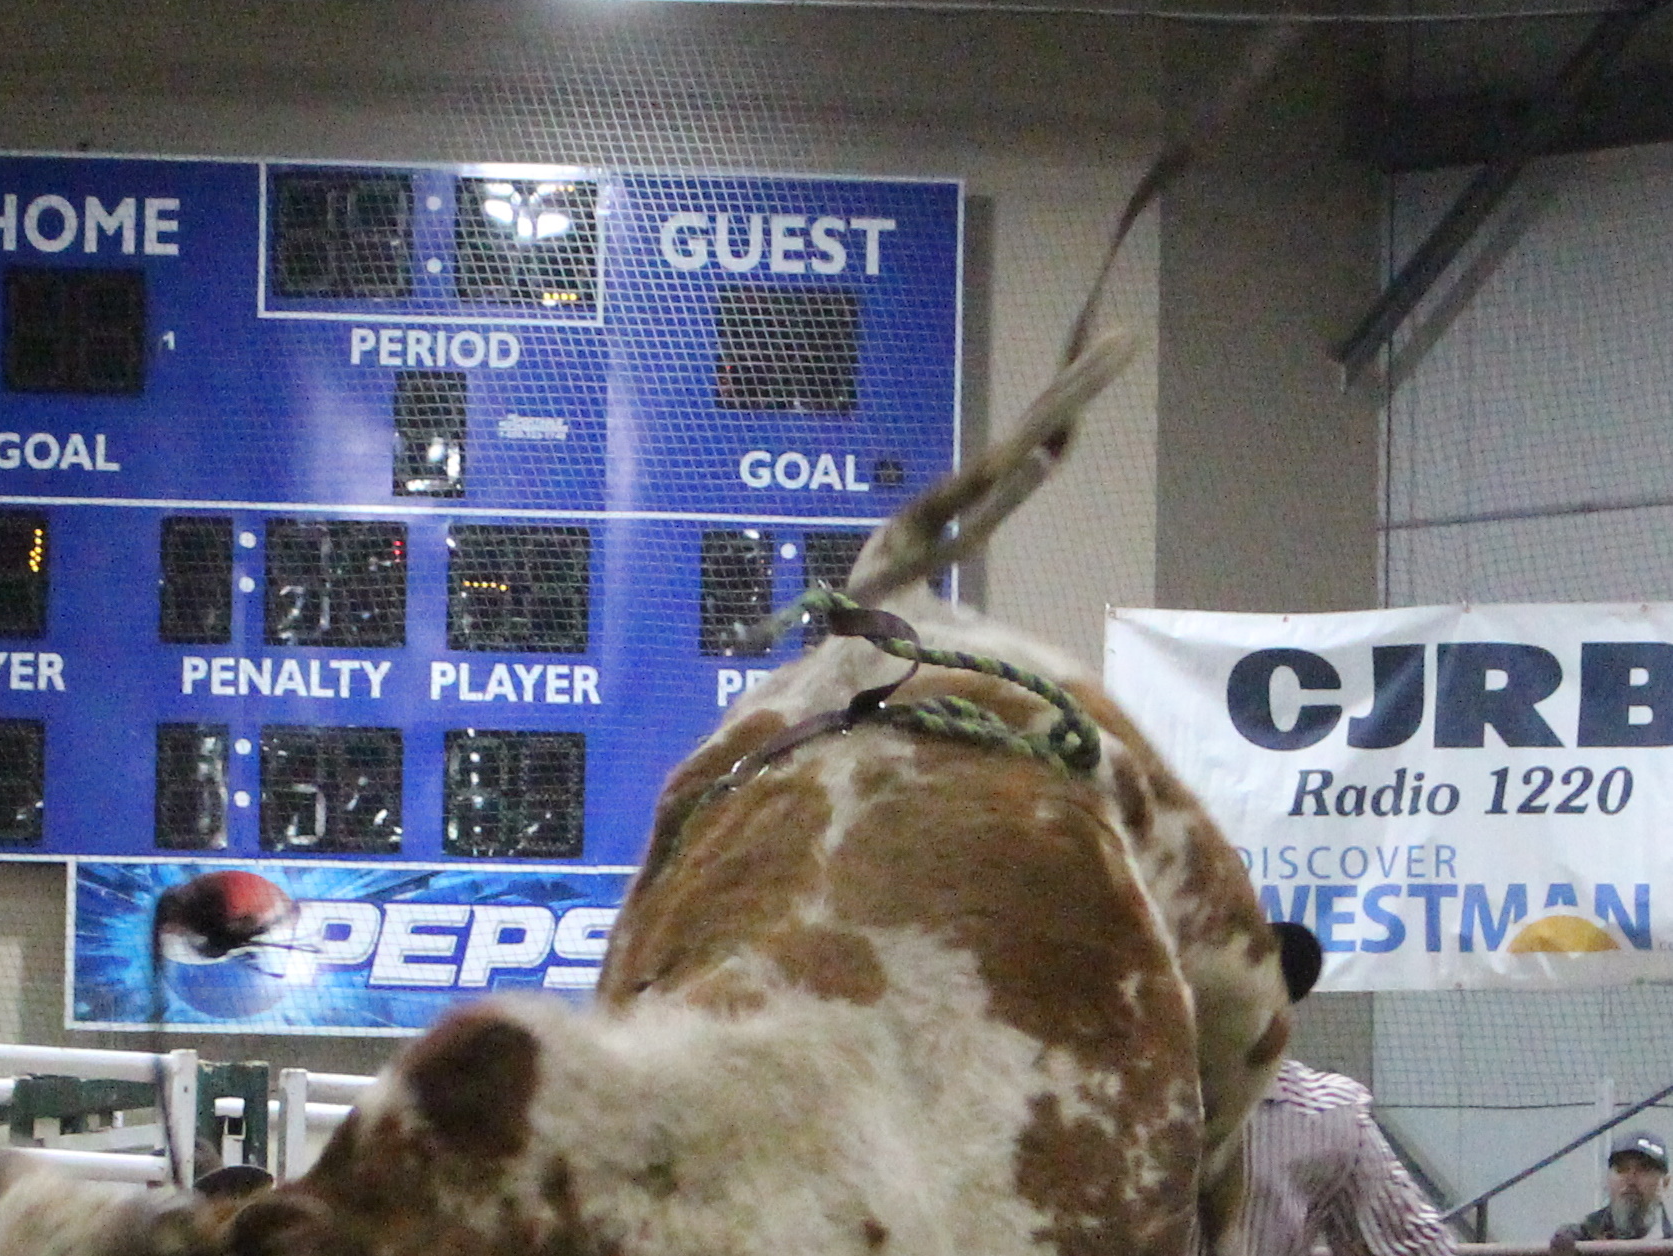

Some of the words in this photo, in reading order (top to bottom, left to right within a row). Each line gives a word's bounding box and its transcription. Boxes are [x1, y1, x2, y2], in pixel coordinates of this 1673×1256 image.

[661, 213, 897, 276] GUEST
[350, 327, 521, 369] PERIOD
[739, 450, 870, 492] GOAL
[181, 655, 392, 699] PENALTY
[429, 661, 601, 705] PLAYER
[1226, 641, 1673, 752] CJRB
[1288, 767, 1461, 818] Radio
[1483, 765, 1634, 816] 1220
[284, 900, 619, 988] PEPS
